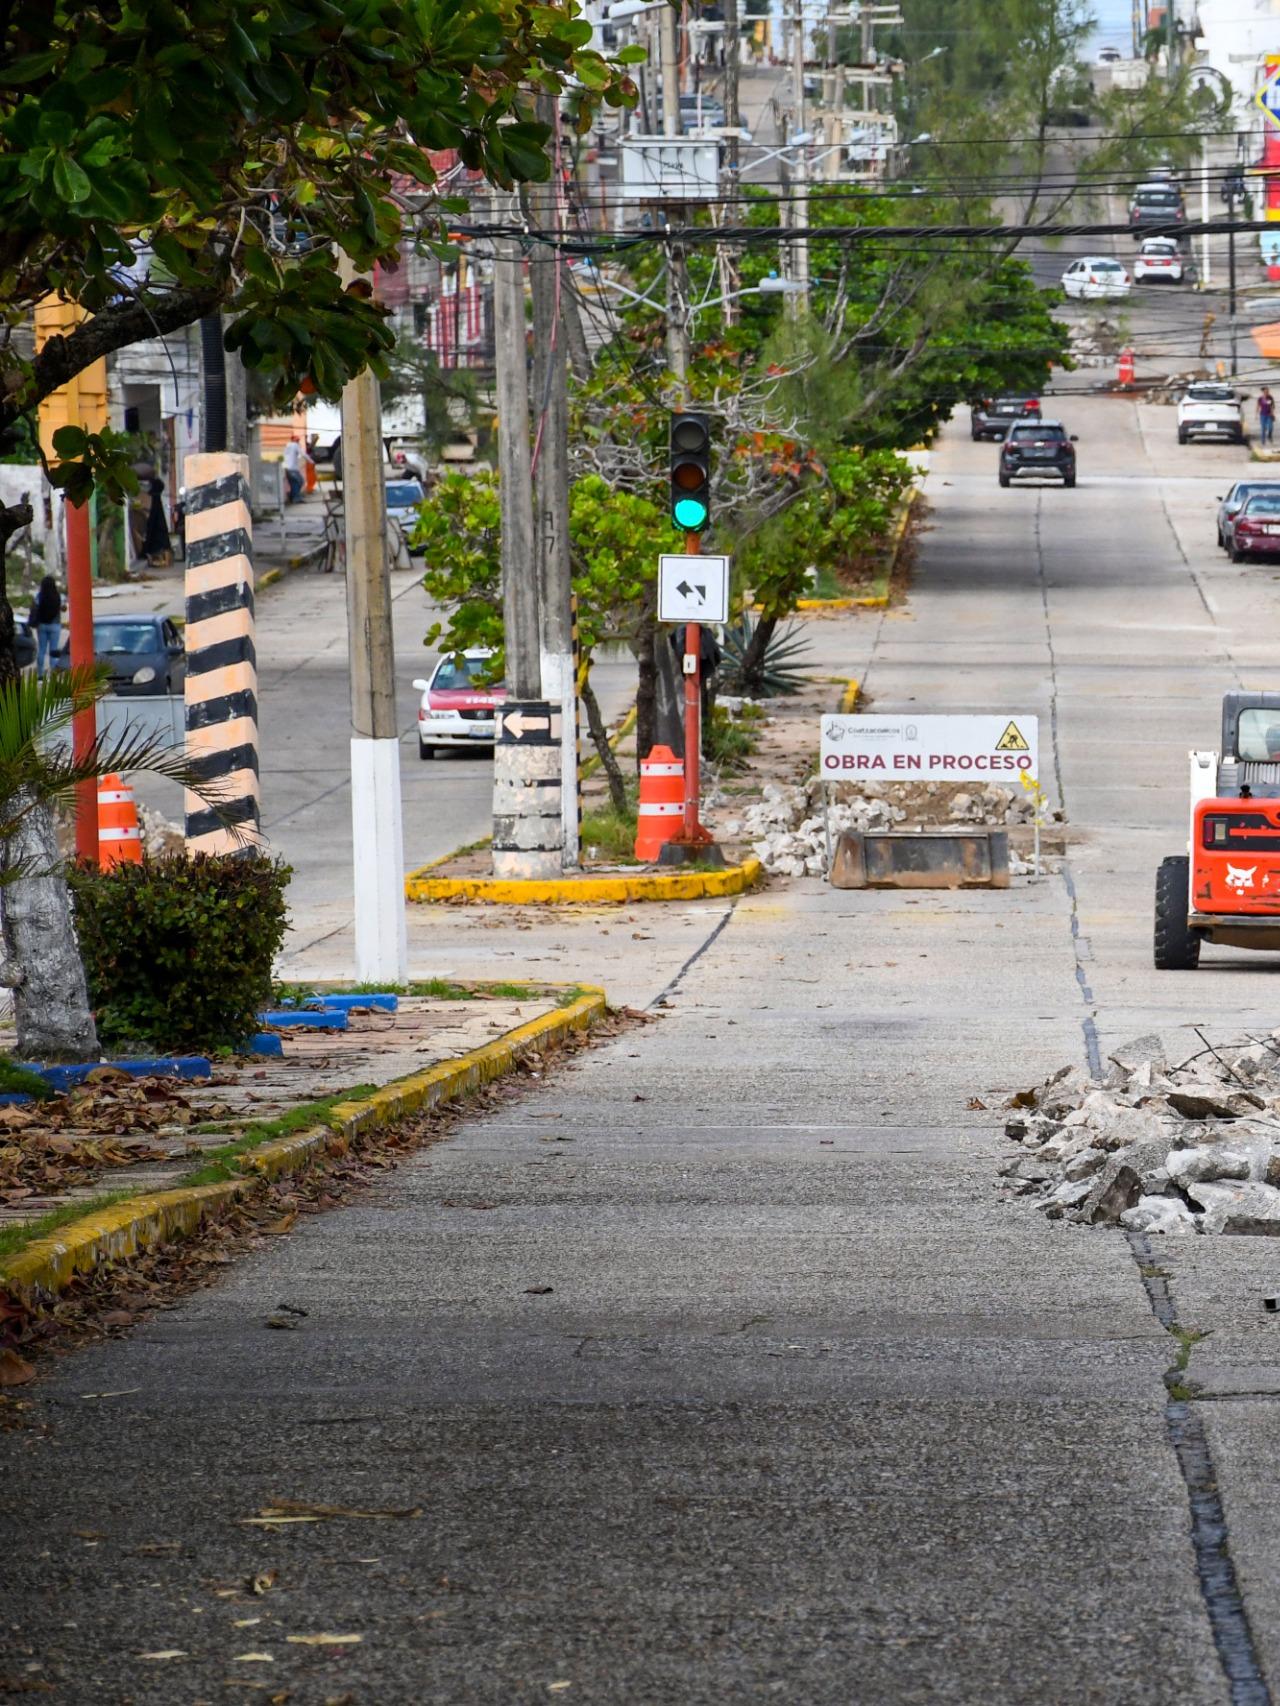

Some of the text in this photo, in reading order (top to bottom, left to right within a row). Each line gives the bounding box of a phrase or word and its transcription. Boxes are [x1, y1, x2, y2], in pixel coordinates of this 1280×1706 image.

[825, 755, 1033, 770] OBRA EN PROCESO
